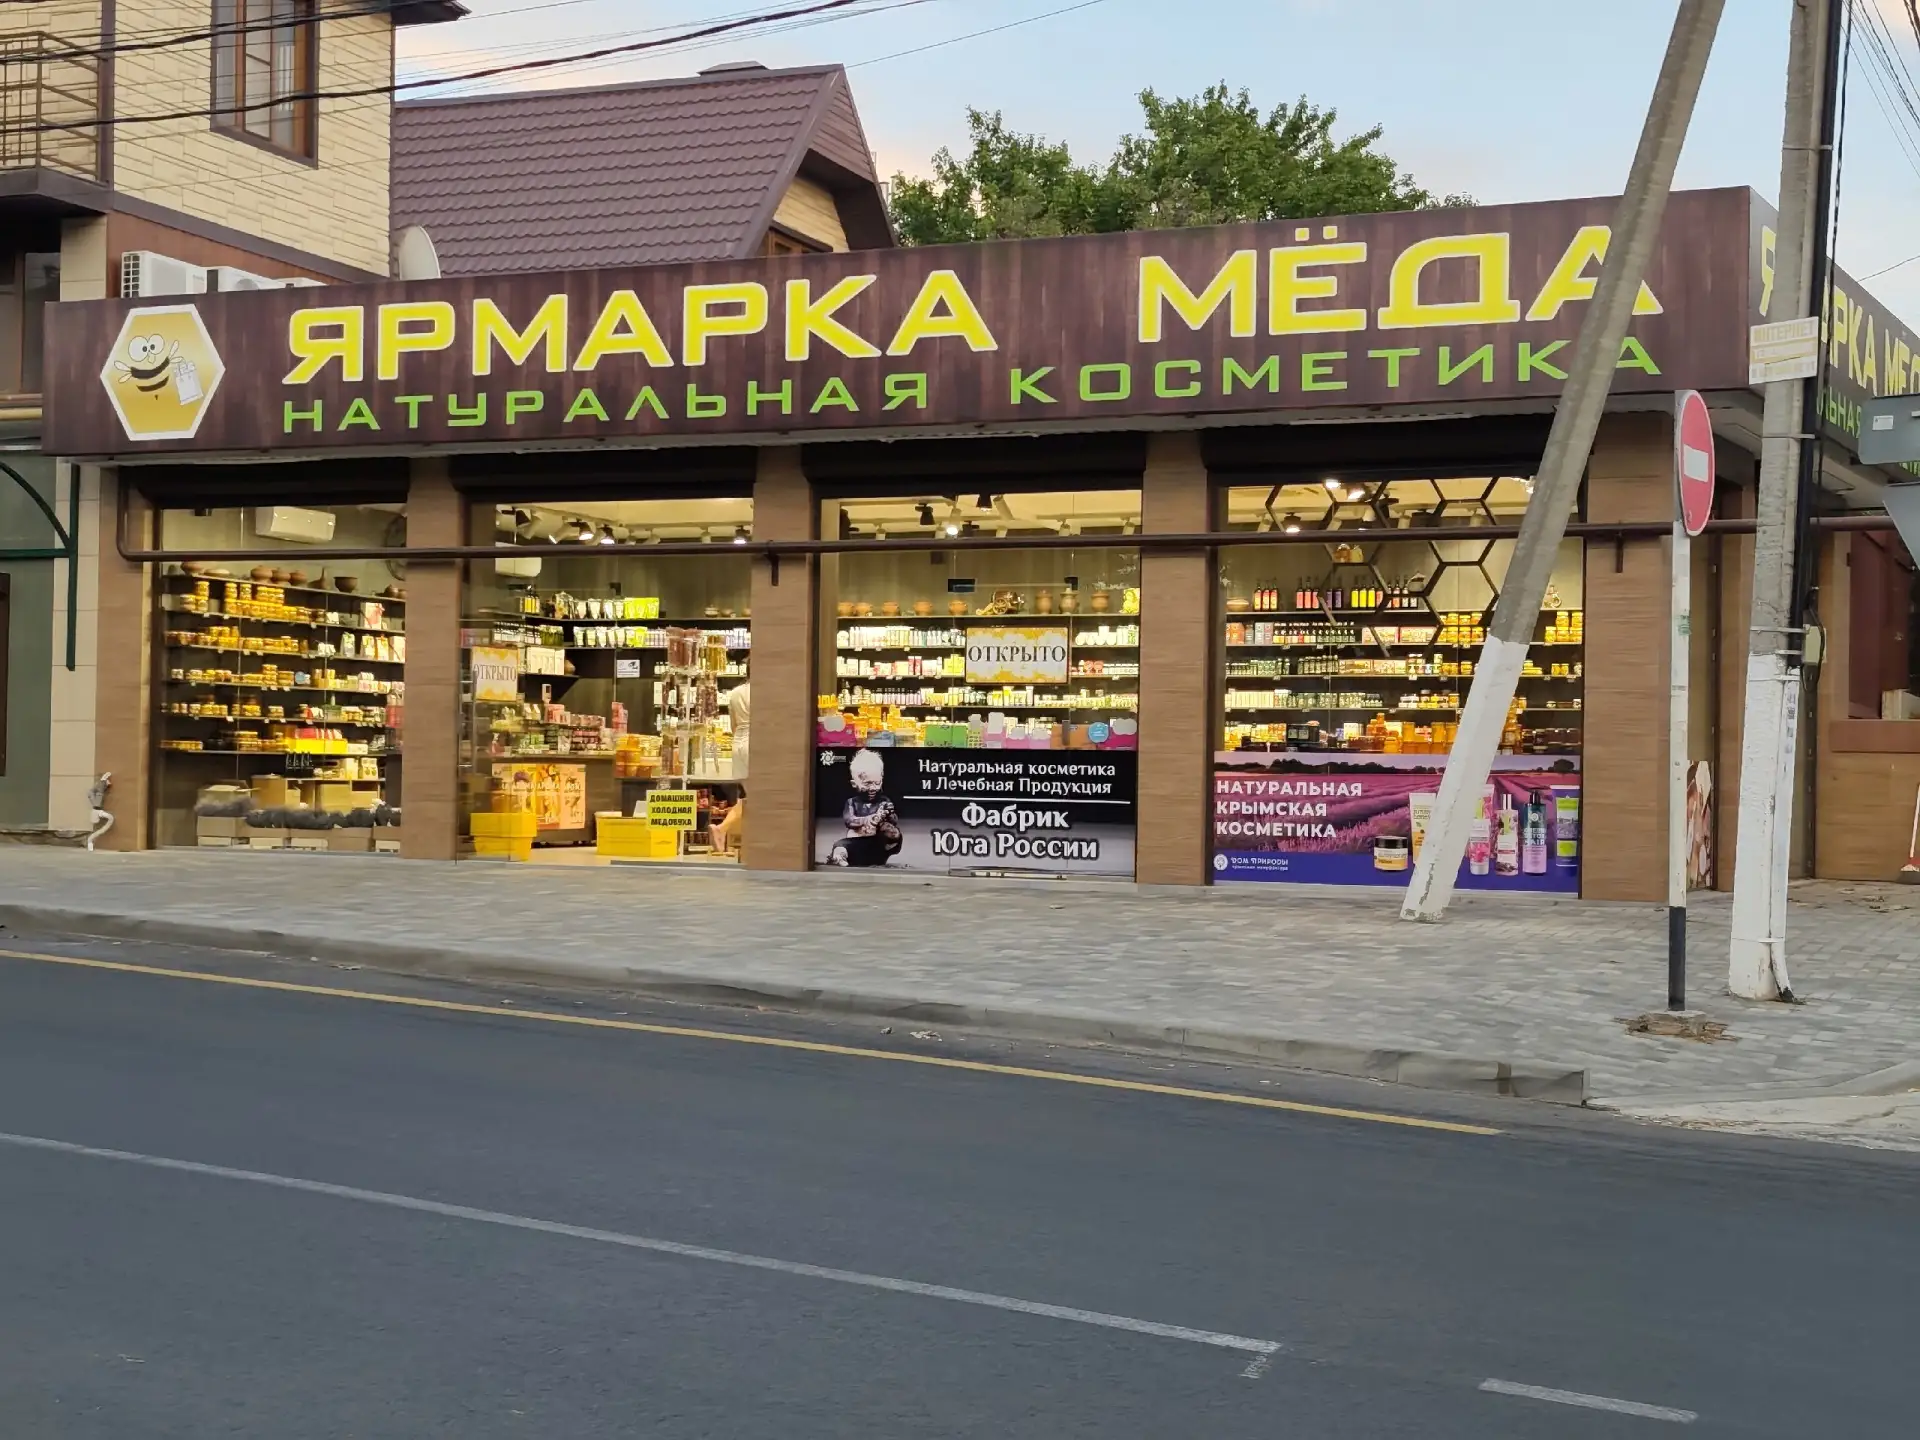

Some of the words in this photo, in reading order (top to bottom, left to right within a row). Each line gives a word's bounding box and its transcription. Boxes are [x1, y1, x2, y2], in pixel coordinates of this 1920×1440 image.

[282, 268, 998, 384] ЯРМАРКА
[1138, 224, 1664, 343] МЁДА
[282, 372, 929, 433] НАТУРАЛЬНАЯ
[1010, 336, 1662, 405] КОСМЕТИКА
[967, 644, 1067, 664] ОТКРЫТО
[473, 663, 516, 682] ОТКРЫТО
[918, 759, 1023, 777] Натуральная
[1028, 763, 1116, 777] косметика
[922, 780, 931, 791] и
[936, 777, 1014, 792] Лечебная
[1019, 779, 1112, 795] Продукция
[1216, 779, 1363, 797] НАТУРАЛЬНАЯ
[650, 795, 694, 803] ДОМАШНЯЯ
[651, 806, 692, 814] ХОЛОДНАЯ
[960, 802, 1070, 833] Фабрик
[1216, 800, 1327, 817] КРЫМСКАЯ
[651, 818, 692, 826] МЕДОВУХА
[1216, 821, 1337, 838] КОСМЕТИКА
[932, 831, 990, 857] Юга
[996, 834, 1099, 859] России
